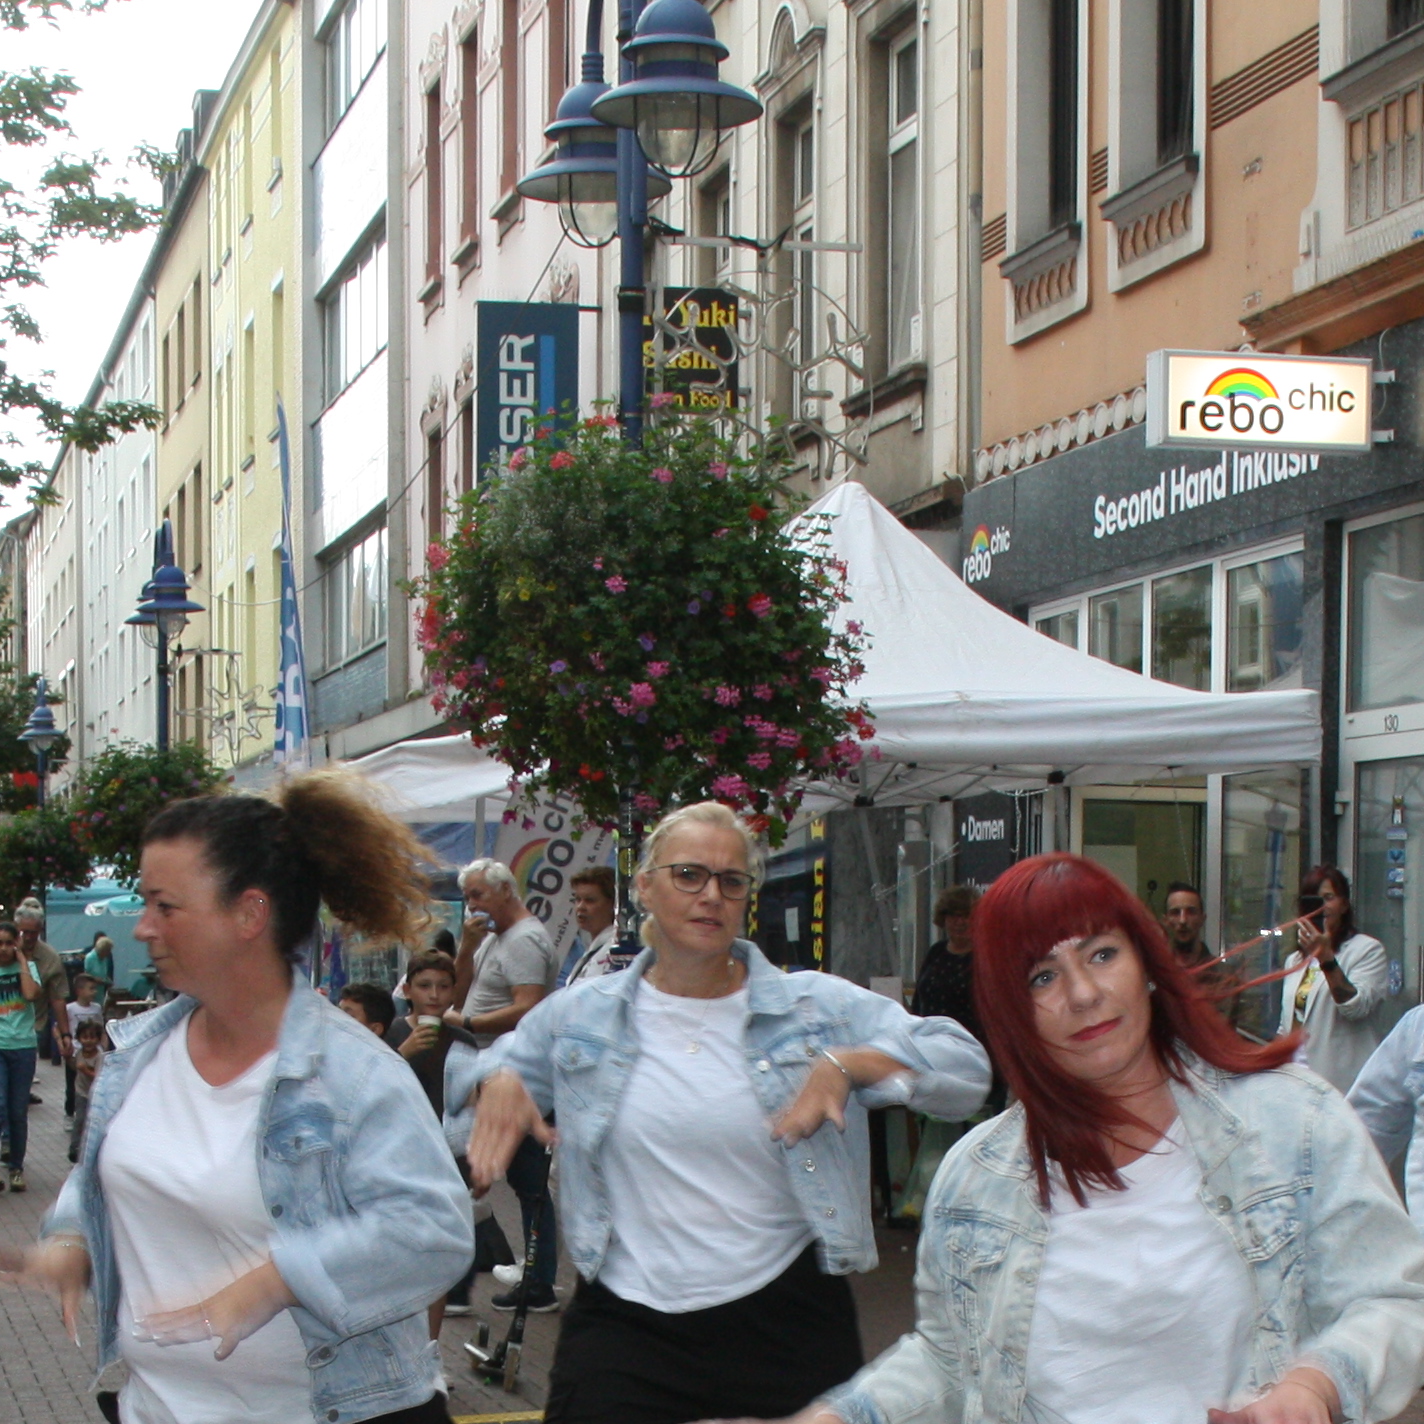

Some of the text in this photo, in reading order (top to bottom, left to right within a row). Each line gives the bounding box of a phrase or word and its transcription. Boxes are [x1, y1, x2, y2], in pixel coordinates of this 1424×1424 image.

[1178, 382, 1356, 434] rebo chic
[1093, 471, 1164, 539] Second
[1170, 449, 1227, 515] Hand
[963, 525, 1012, 584] rebo chic
[1383, 714, 1399, 732] 130
[968, 815, 1005, 842] Damen
